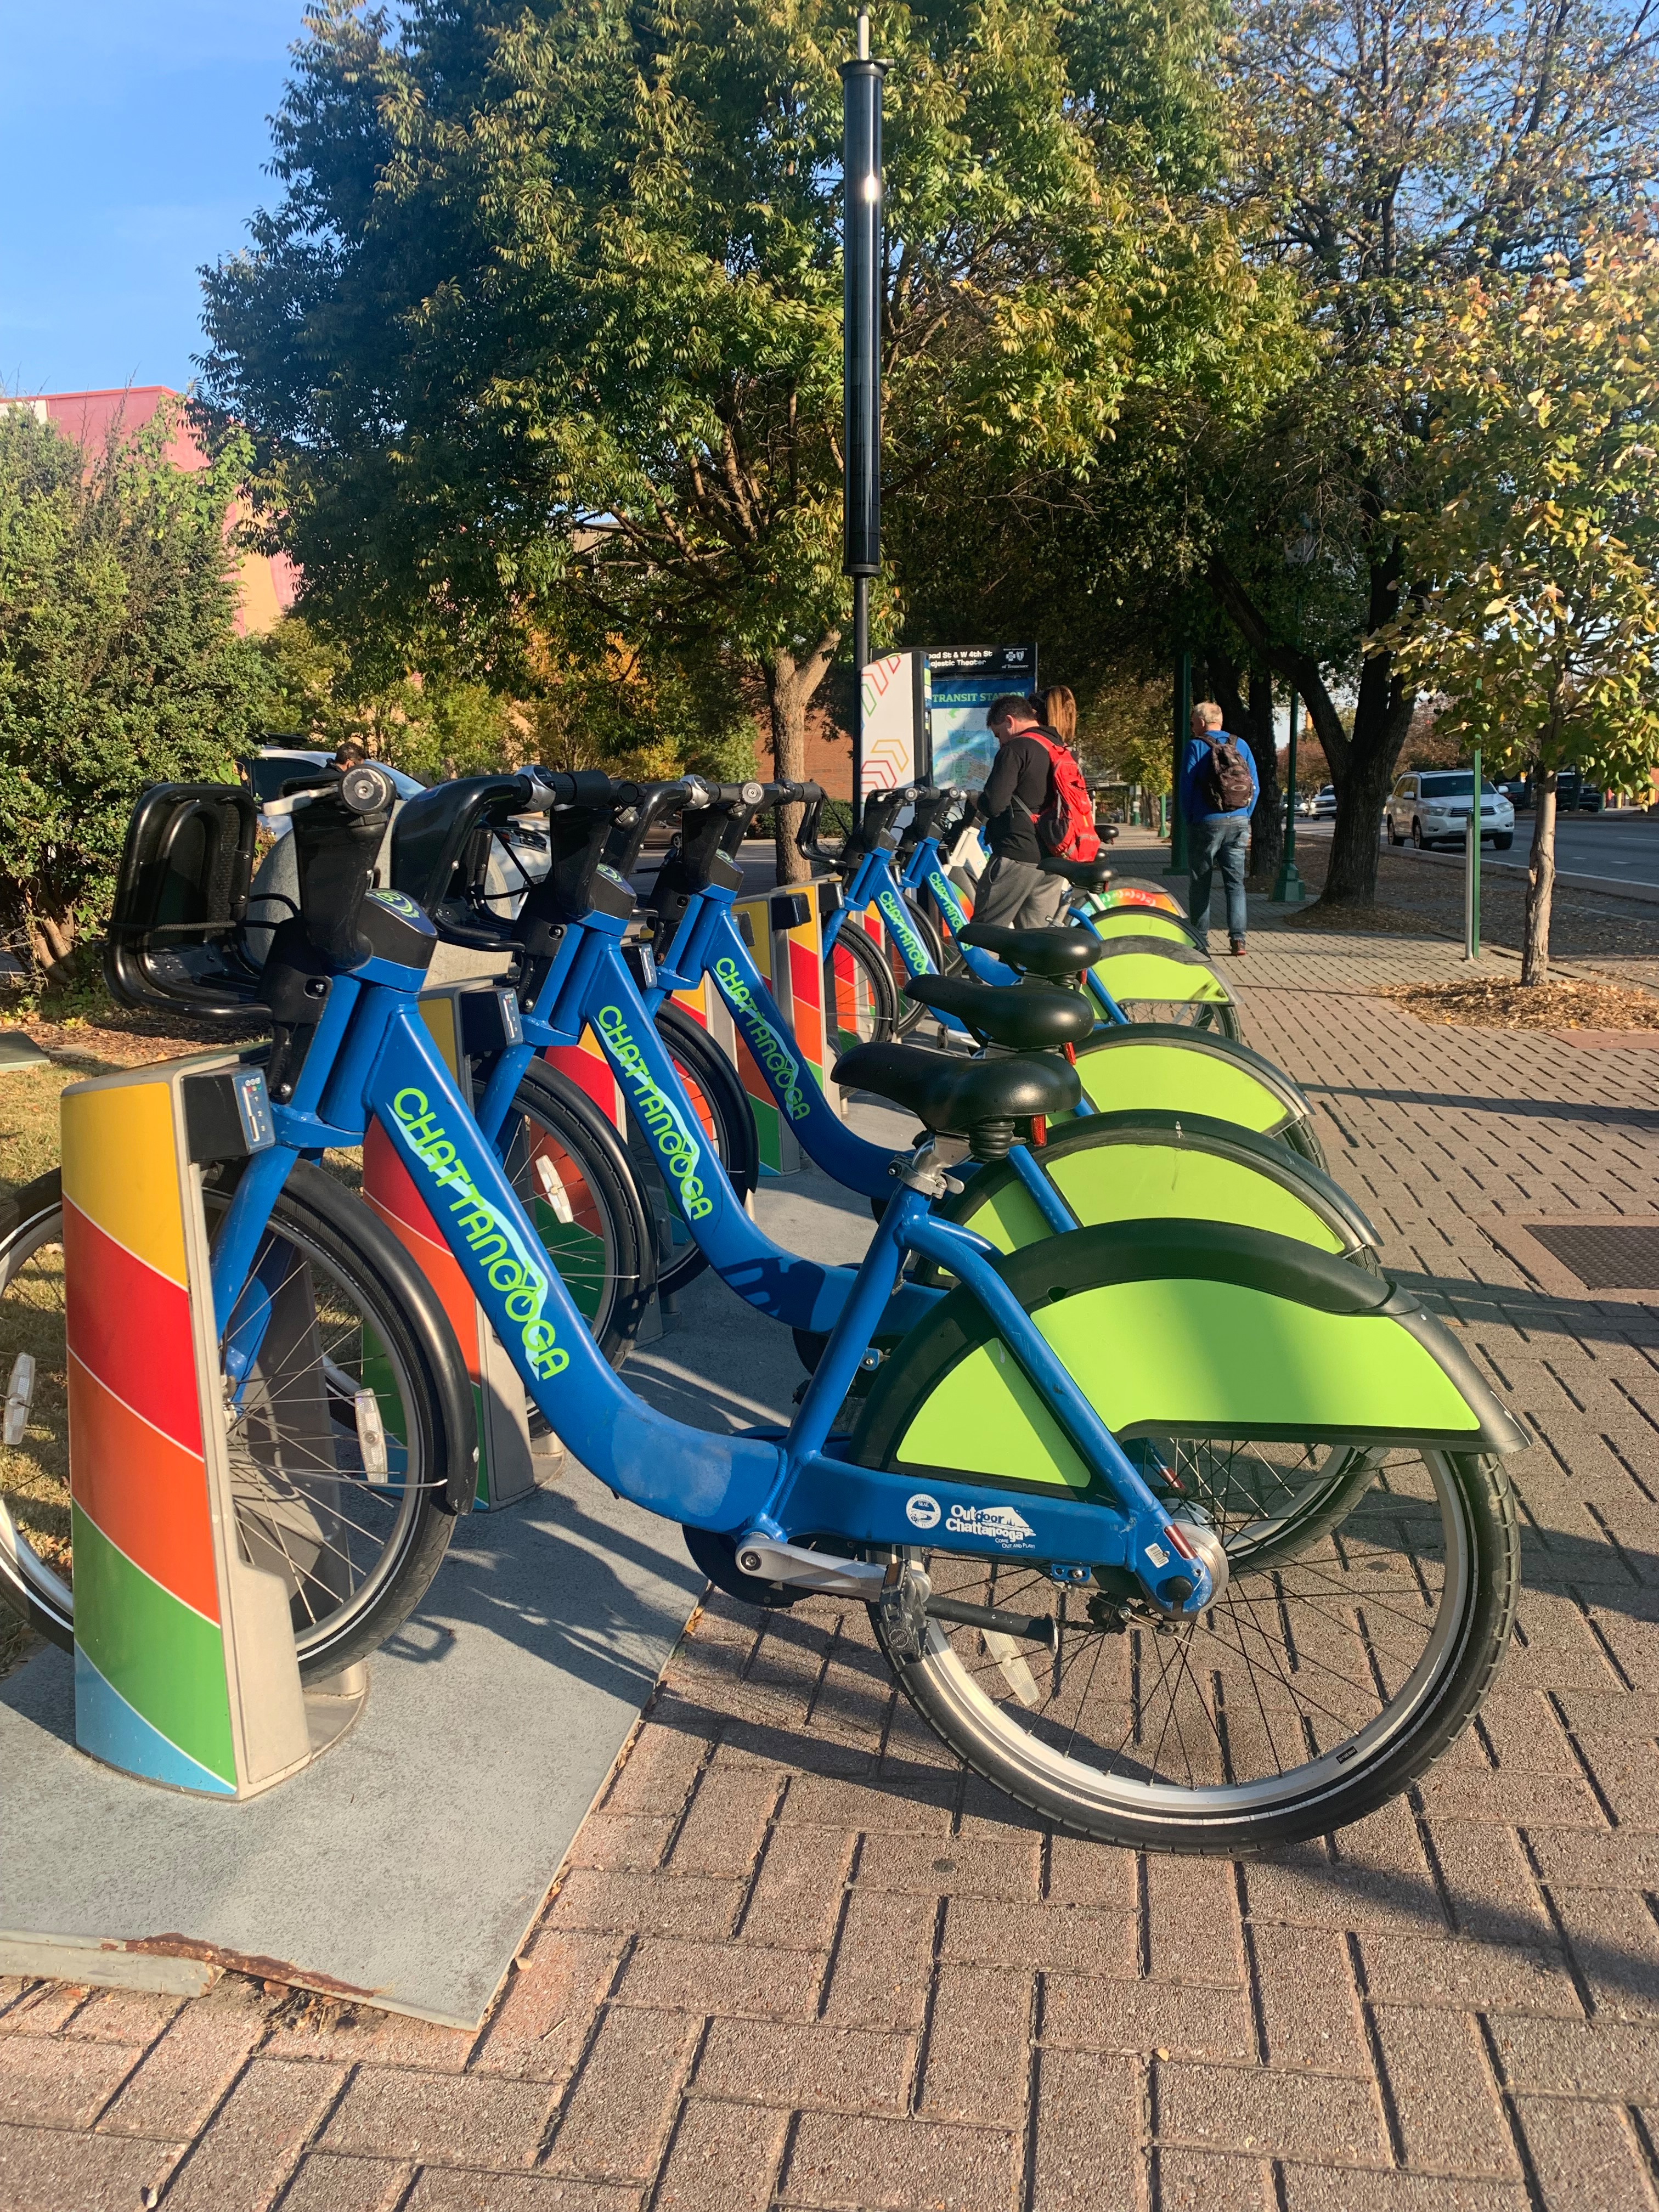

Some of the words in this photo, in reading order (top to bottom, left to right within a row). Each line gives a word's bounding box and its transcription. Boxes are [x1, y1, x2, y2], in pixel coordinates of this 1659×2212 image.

[930, 659, 955, 668] ajestic
[932, 692, 978, 703] TRANSIT
[879, 890, 930, 975] CHATTANOO
[716, 957, 811, 1120] CHATTANOOGA
[599, 1006, 713, 1220] CHATTANOOGA
[393, 1087, 570, 1380] CHATTANOOGA
[945, 1517, 1024, 1543] Chattanooga
[951, 1504, 1005, 1524] Outdoor
